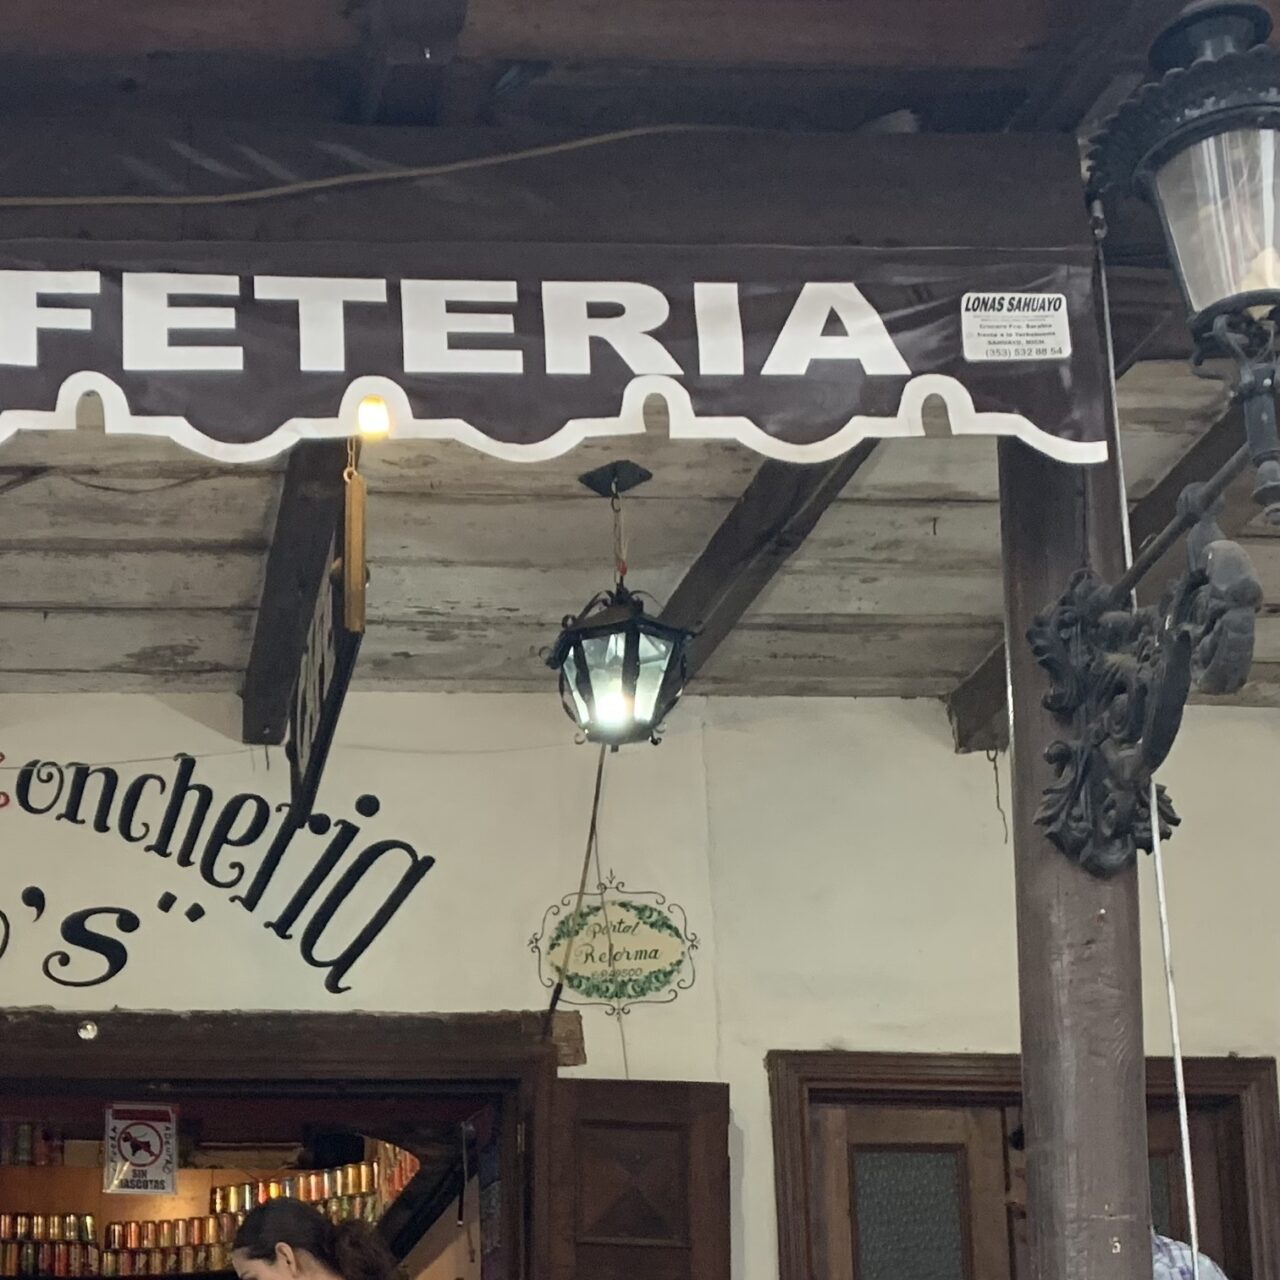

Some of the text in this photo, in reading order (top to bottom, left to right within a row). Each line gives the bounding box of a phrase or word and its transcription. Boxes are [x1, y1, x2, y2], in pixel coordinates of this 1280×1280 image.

[965, 296, 1062, 313] LONAS SAHUAYO
[585, 918, 641, 940] Portal
